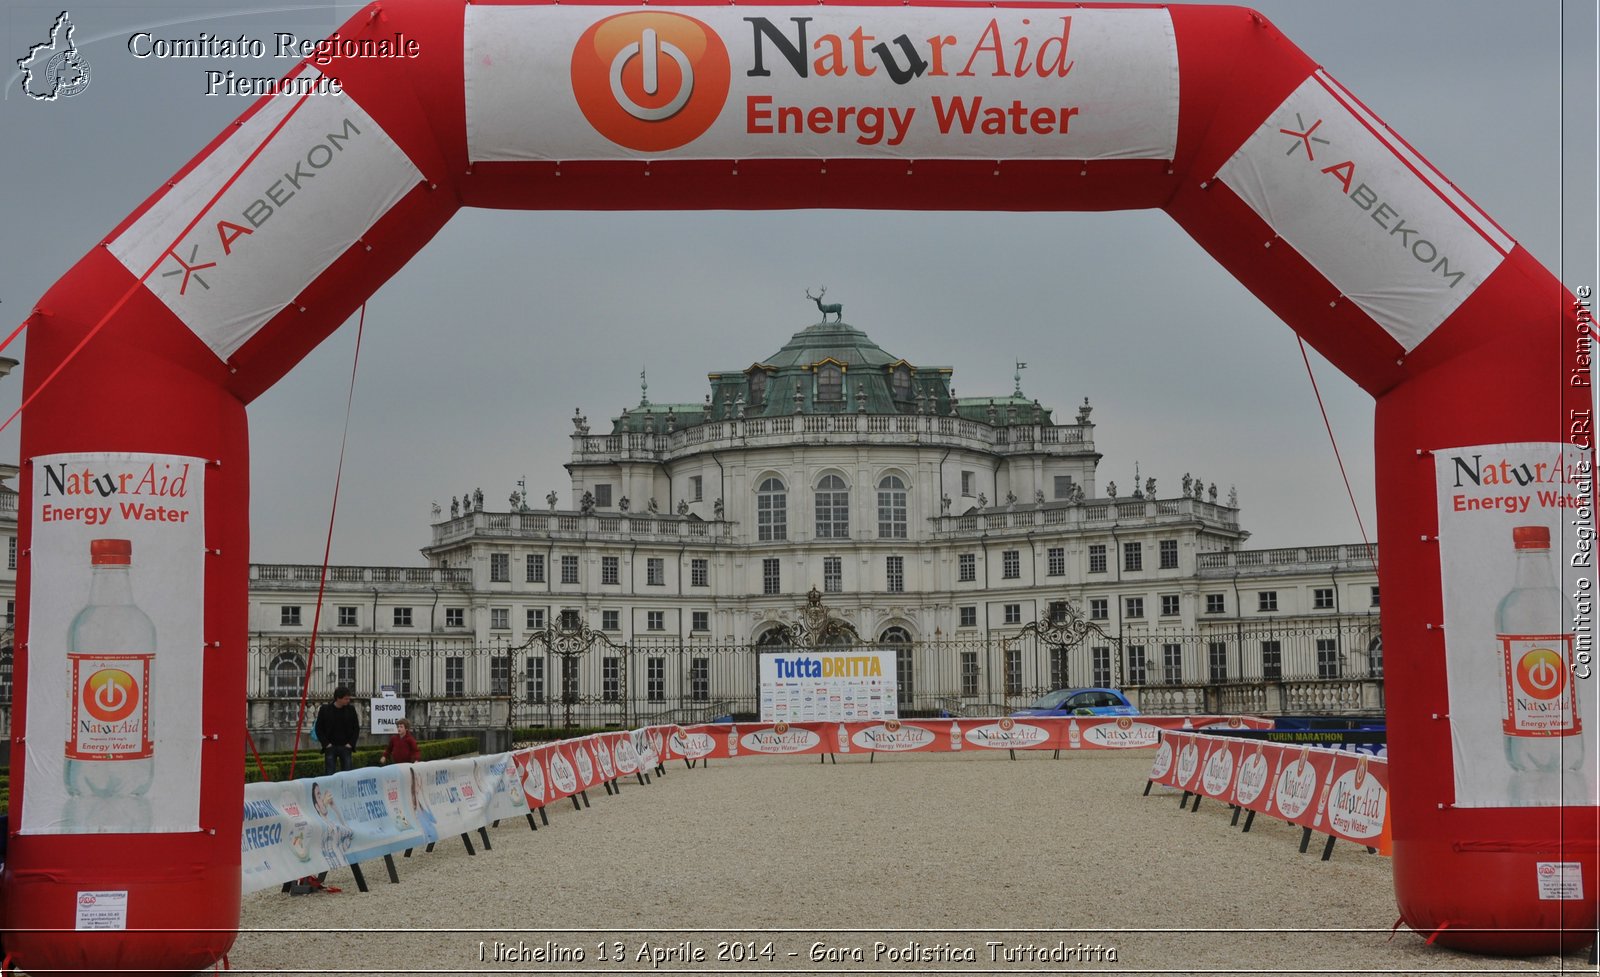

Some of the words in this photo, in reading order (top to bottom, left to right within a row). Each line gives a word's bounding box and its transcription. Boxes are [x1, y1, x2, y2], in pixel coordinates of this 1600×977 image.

[743, 16, 1075, 85] NaturAid
[746, 95, 916, 146] Energy
[931, 95, 1079, 135] Water
[217, 118, 361, 256] ABEKOM
[1321, 161, 1466, 289] ABEKOM
[43, 463, 190, 498] NaturAid
[1453, 495, 1531, 513] Energy
[43, 504, 112, 525] Energy
[119, 502, 189, 522] Water
[775, 656, 882, 678] TuttaDRITTA
[80, 719, 140, 734] NaturAid
[1094, 727, 1156, 740] NaturAid
[1521, 720, 1547, 729] Energy
[751, 731, 809, 744] NaturAid
[864, 729, 924, 743] NaturAid
[976, 728, 1038, 740] NaturAid
[1295, 733, 1343, 741] MARATHON
[82, 743, 110, 751] Energy
[1333, 781, 1382, 819] NaturAid
[1333, 814, 1350, 832] Energy
[1351, 818, 1368, 833] Water
